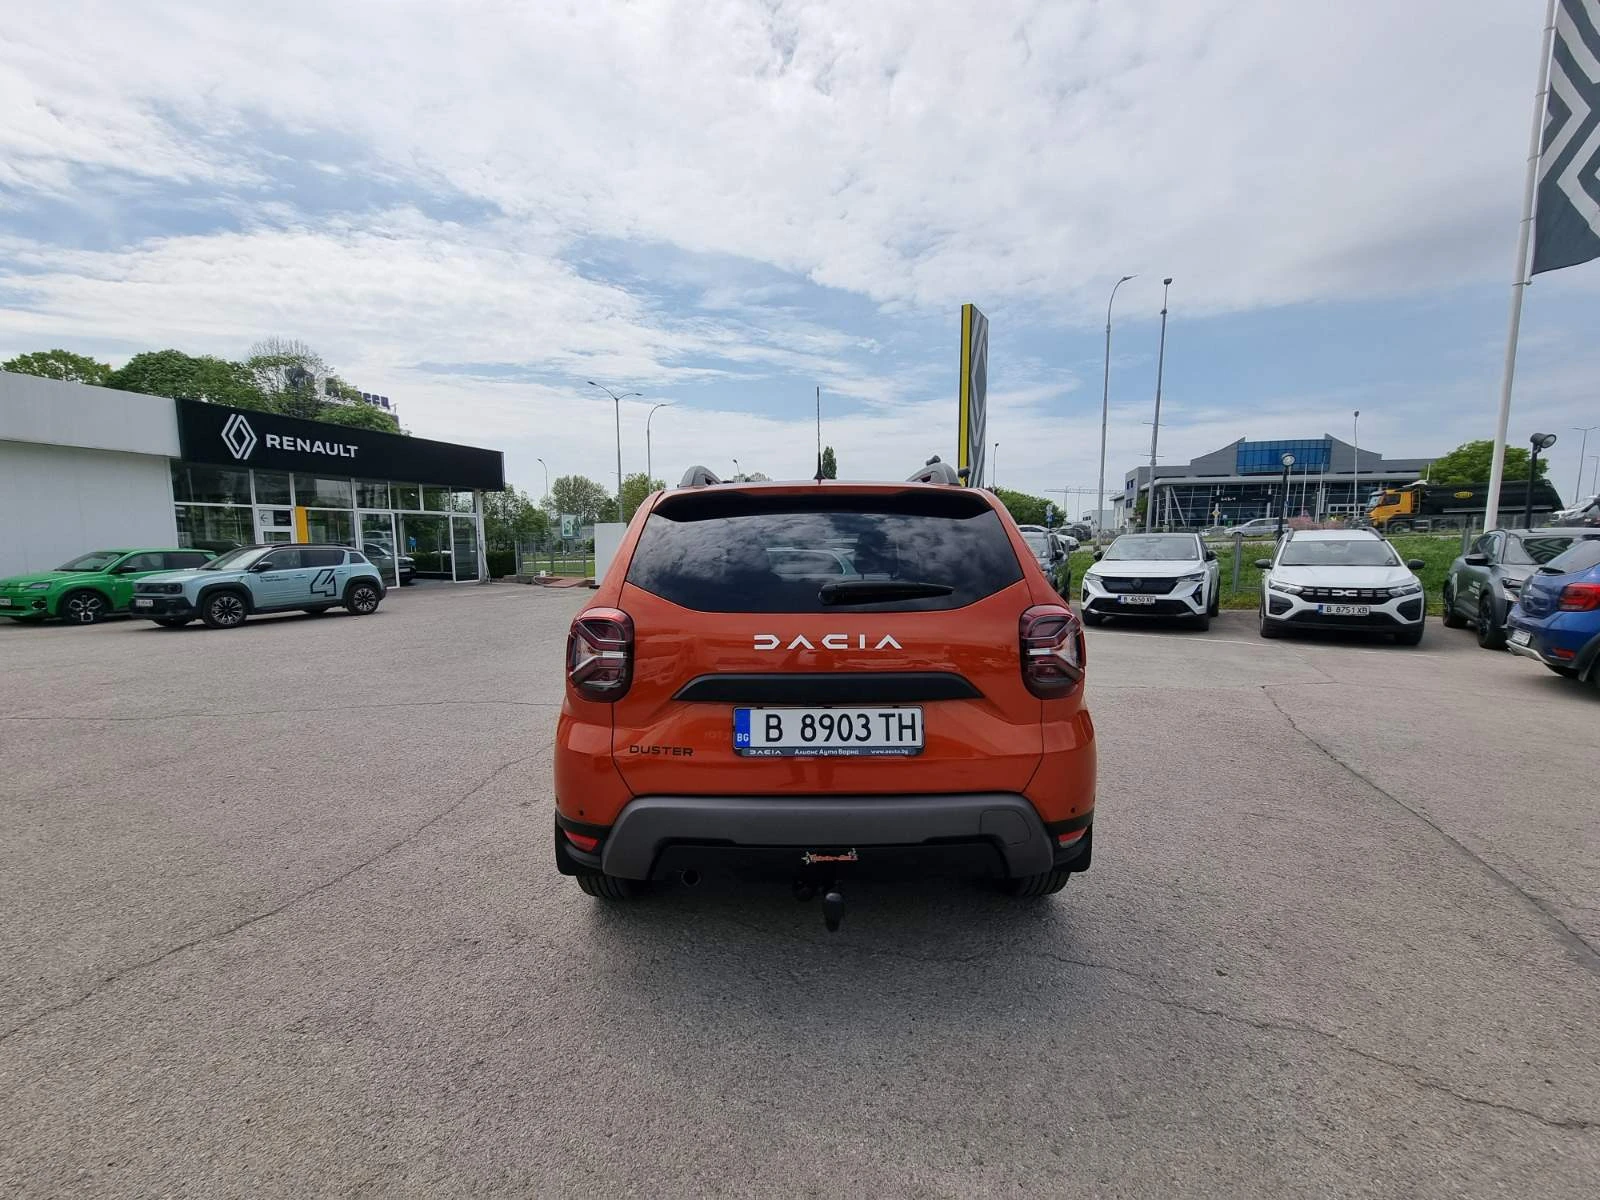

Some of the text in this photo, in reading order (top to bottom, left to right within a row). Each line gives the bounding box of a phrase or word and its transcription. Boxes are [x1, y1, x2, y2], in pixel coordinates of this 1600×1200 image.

[265, 433, 359, 458] RENAULT
[310, 568, 337, 597] 4
[753, 634, 903, 650] DACIA
[737, 733, 749, 742] BG
[765, 713, 917, 742] B 8903 TH
[629, 745, 694, 757] DUSTER
